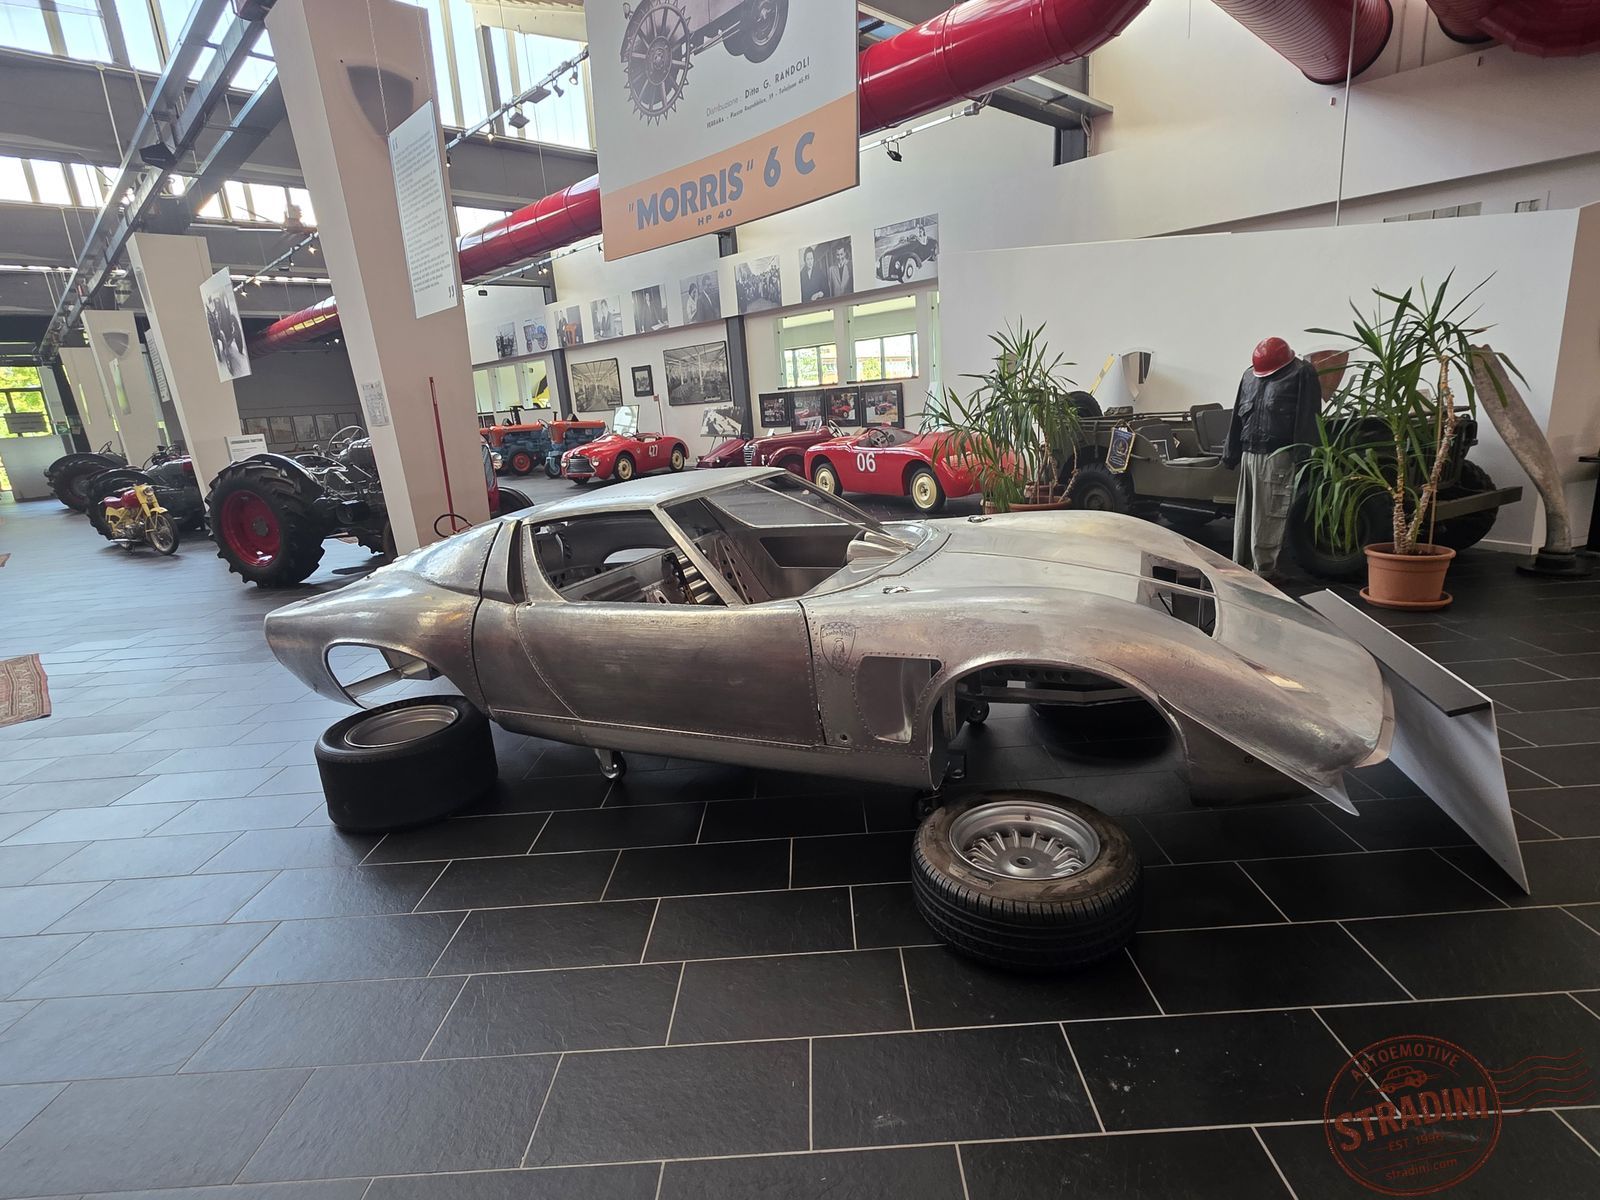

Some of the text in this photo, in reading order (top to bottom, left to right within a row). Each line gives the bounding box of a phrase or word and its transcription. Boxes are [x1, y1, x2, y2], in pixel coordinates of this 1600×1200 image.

[763, 79, 771, 89] G.
[775, 55, 810, 83] RANDOLI
[629, 131, 816, 231] "MORRIS" 6 C
[697, 208, 733, 226] HP 40
[856, 452, 876, 472] 06
